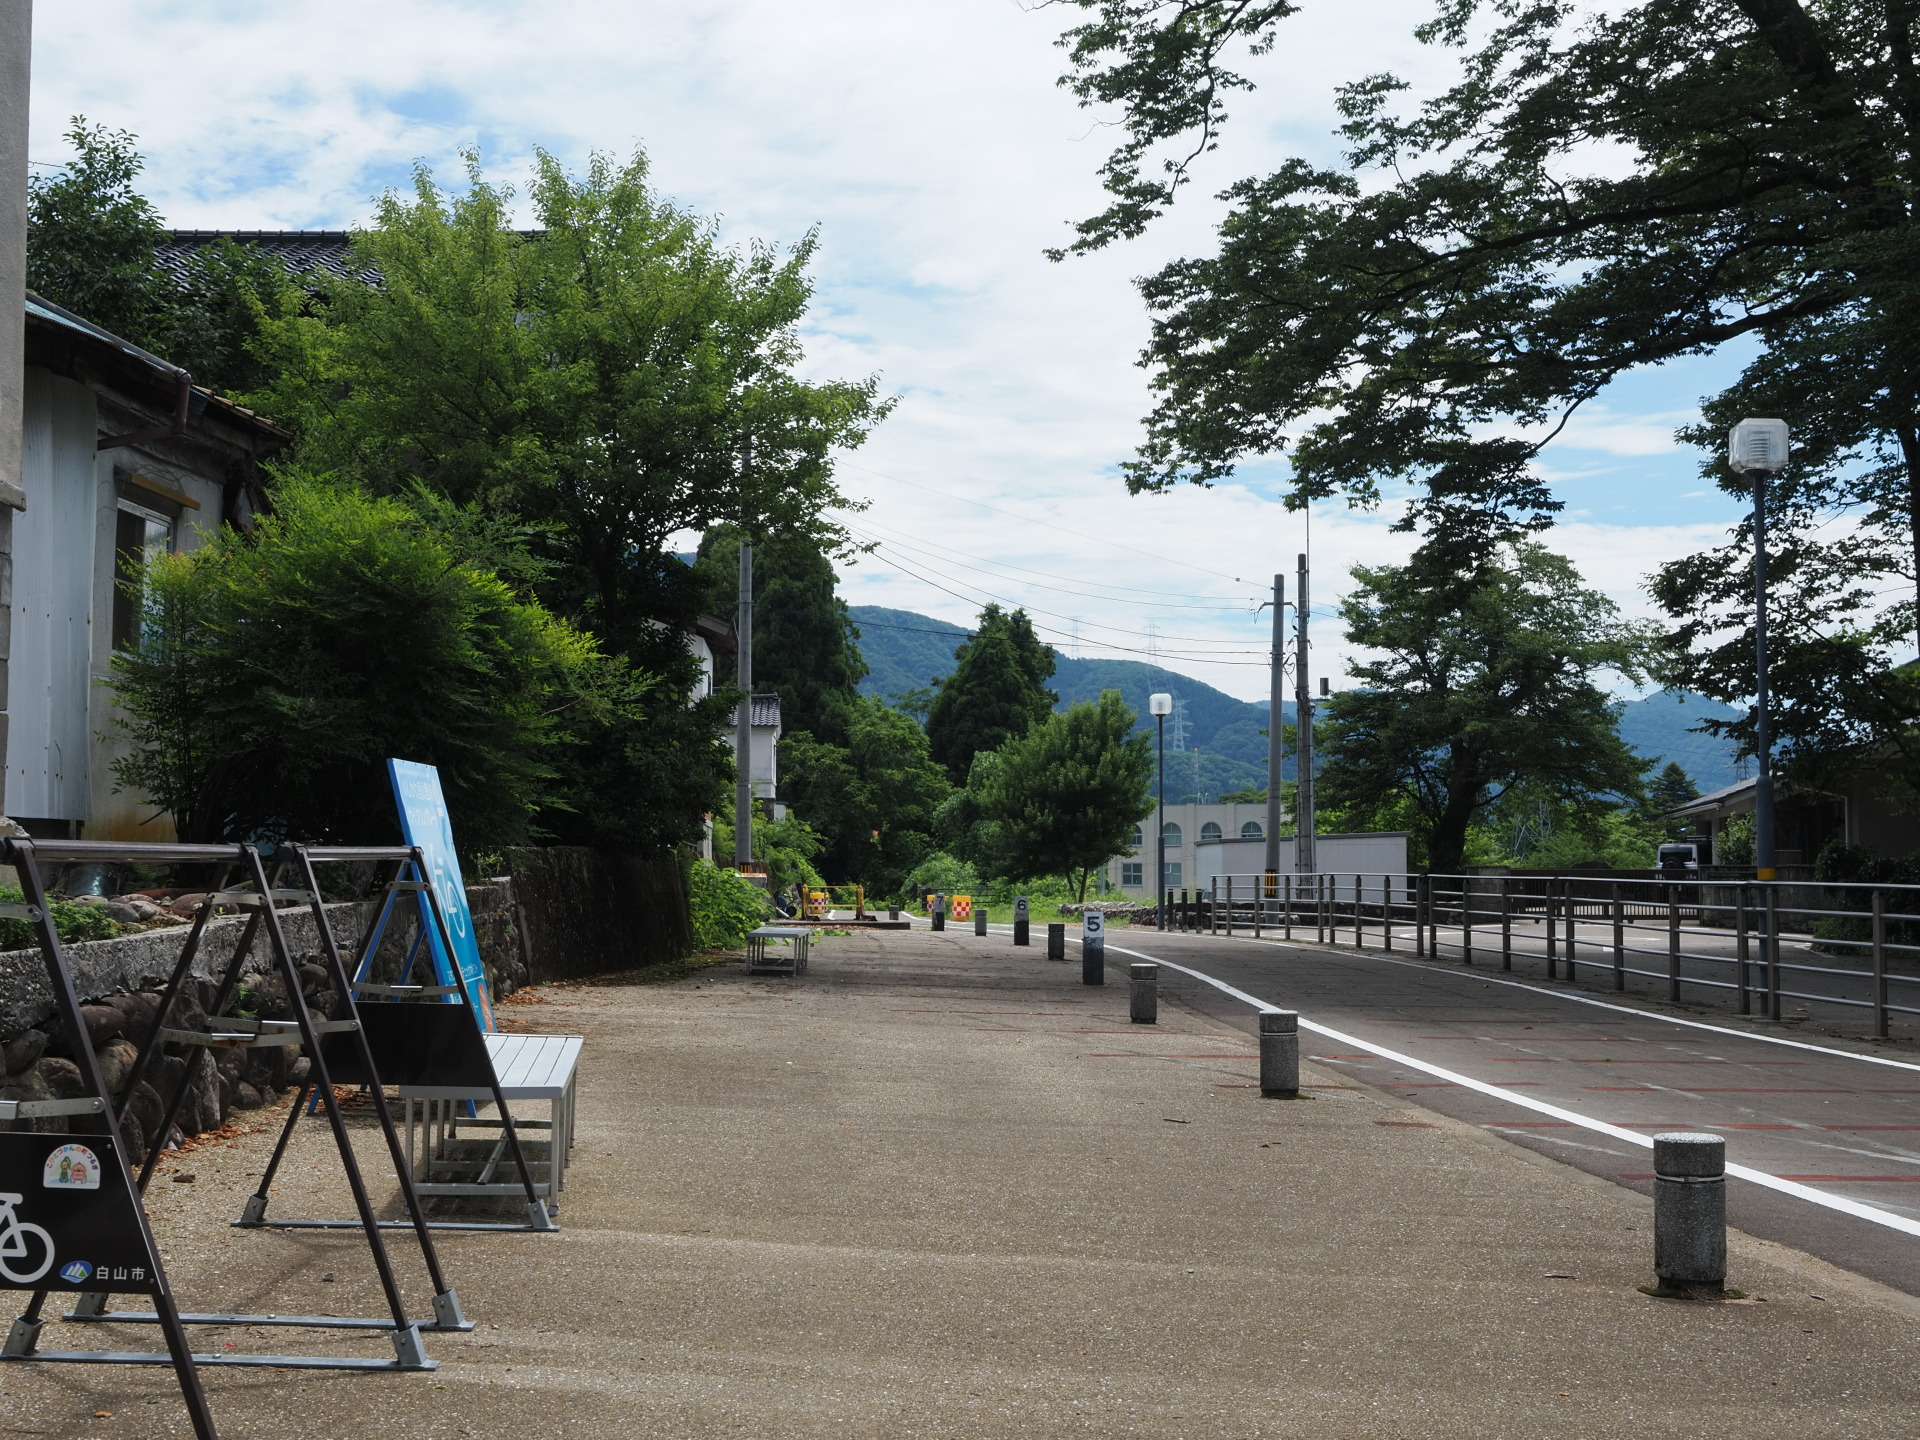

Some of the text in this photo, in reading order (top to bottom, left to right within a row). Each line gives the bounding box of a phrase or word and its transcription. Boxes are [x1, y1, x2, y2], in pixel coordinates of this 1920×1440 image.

[936, 895, 944, 905] 7
[1017, 899, 1027, 911] 6
[1086, 916, 1101, 932] 5
[96, 1265, 146, 1281] 白山市
